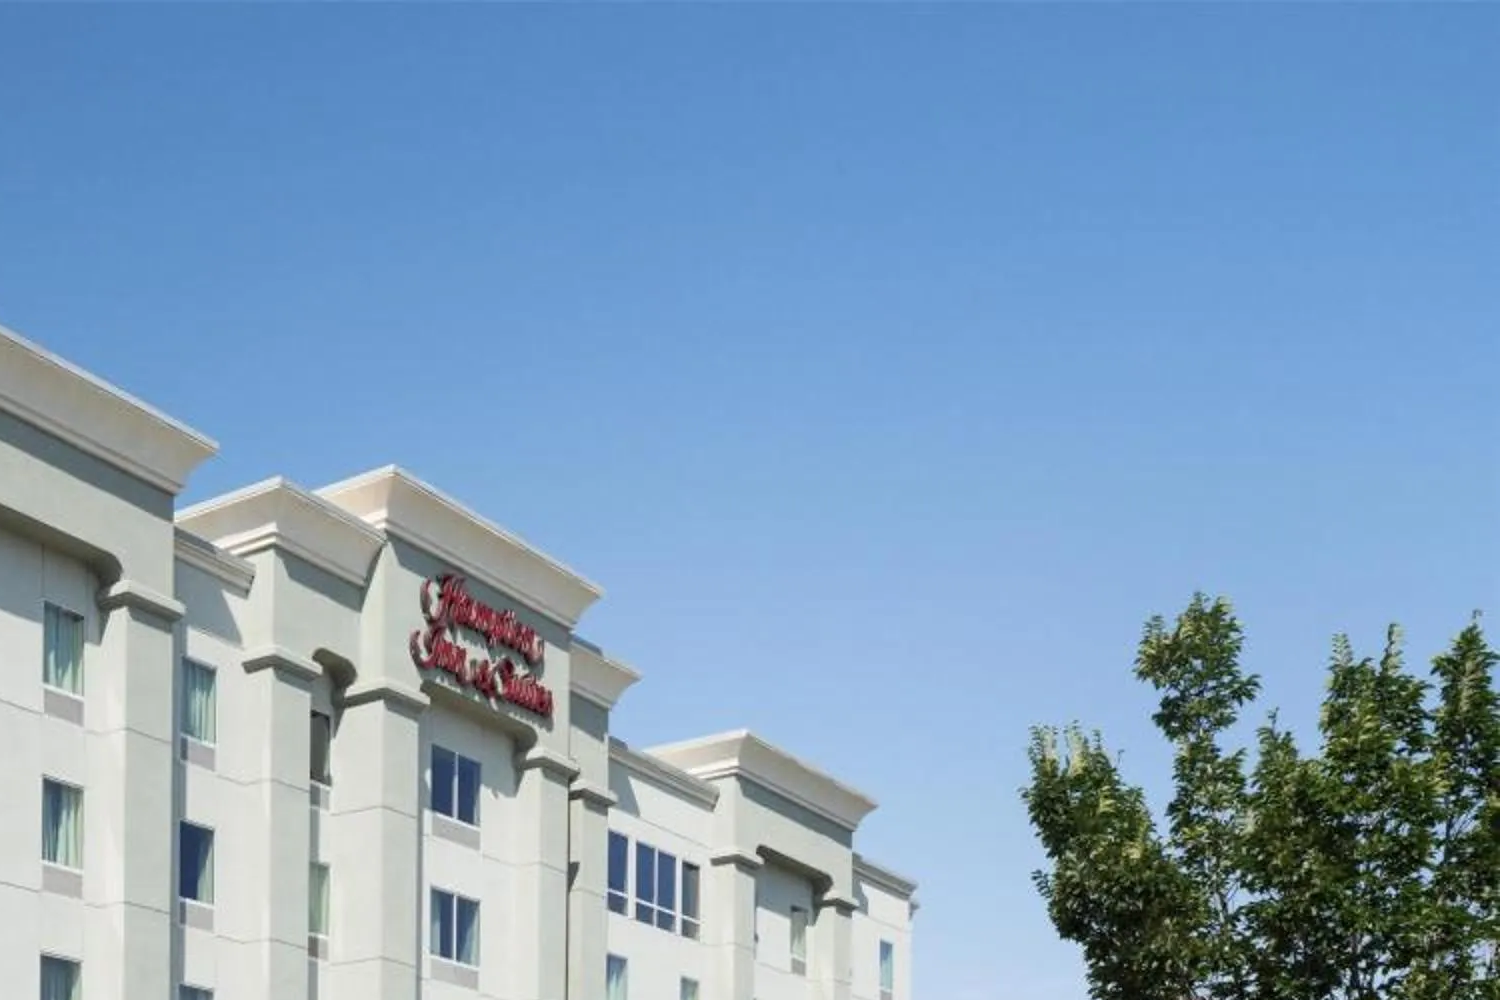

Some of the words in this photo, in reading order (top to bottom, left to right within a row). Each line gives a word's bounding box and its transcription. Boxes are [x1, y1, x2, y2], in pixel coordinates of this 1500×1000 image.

[420, 573, 544, 664] Hampton
[409, 626, 467, 683] Inn
[493, 657, 553, 718] Suites
